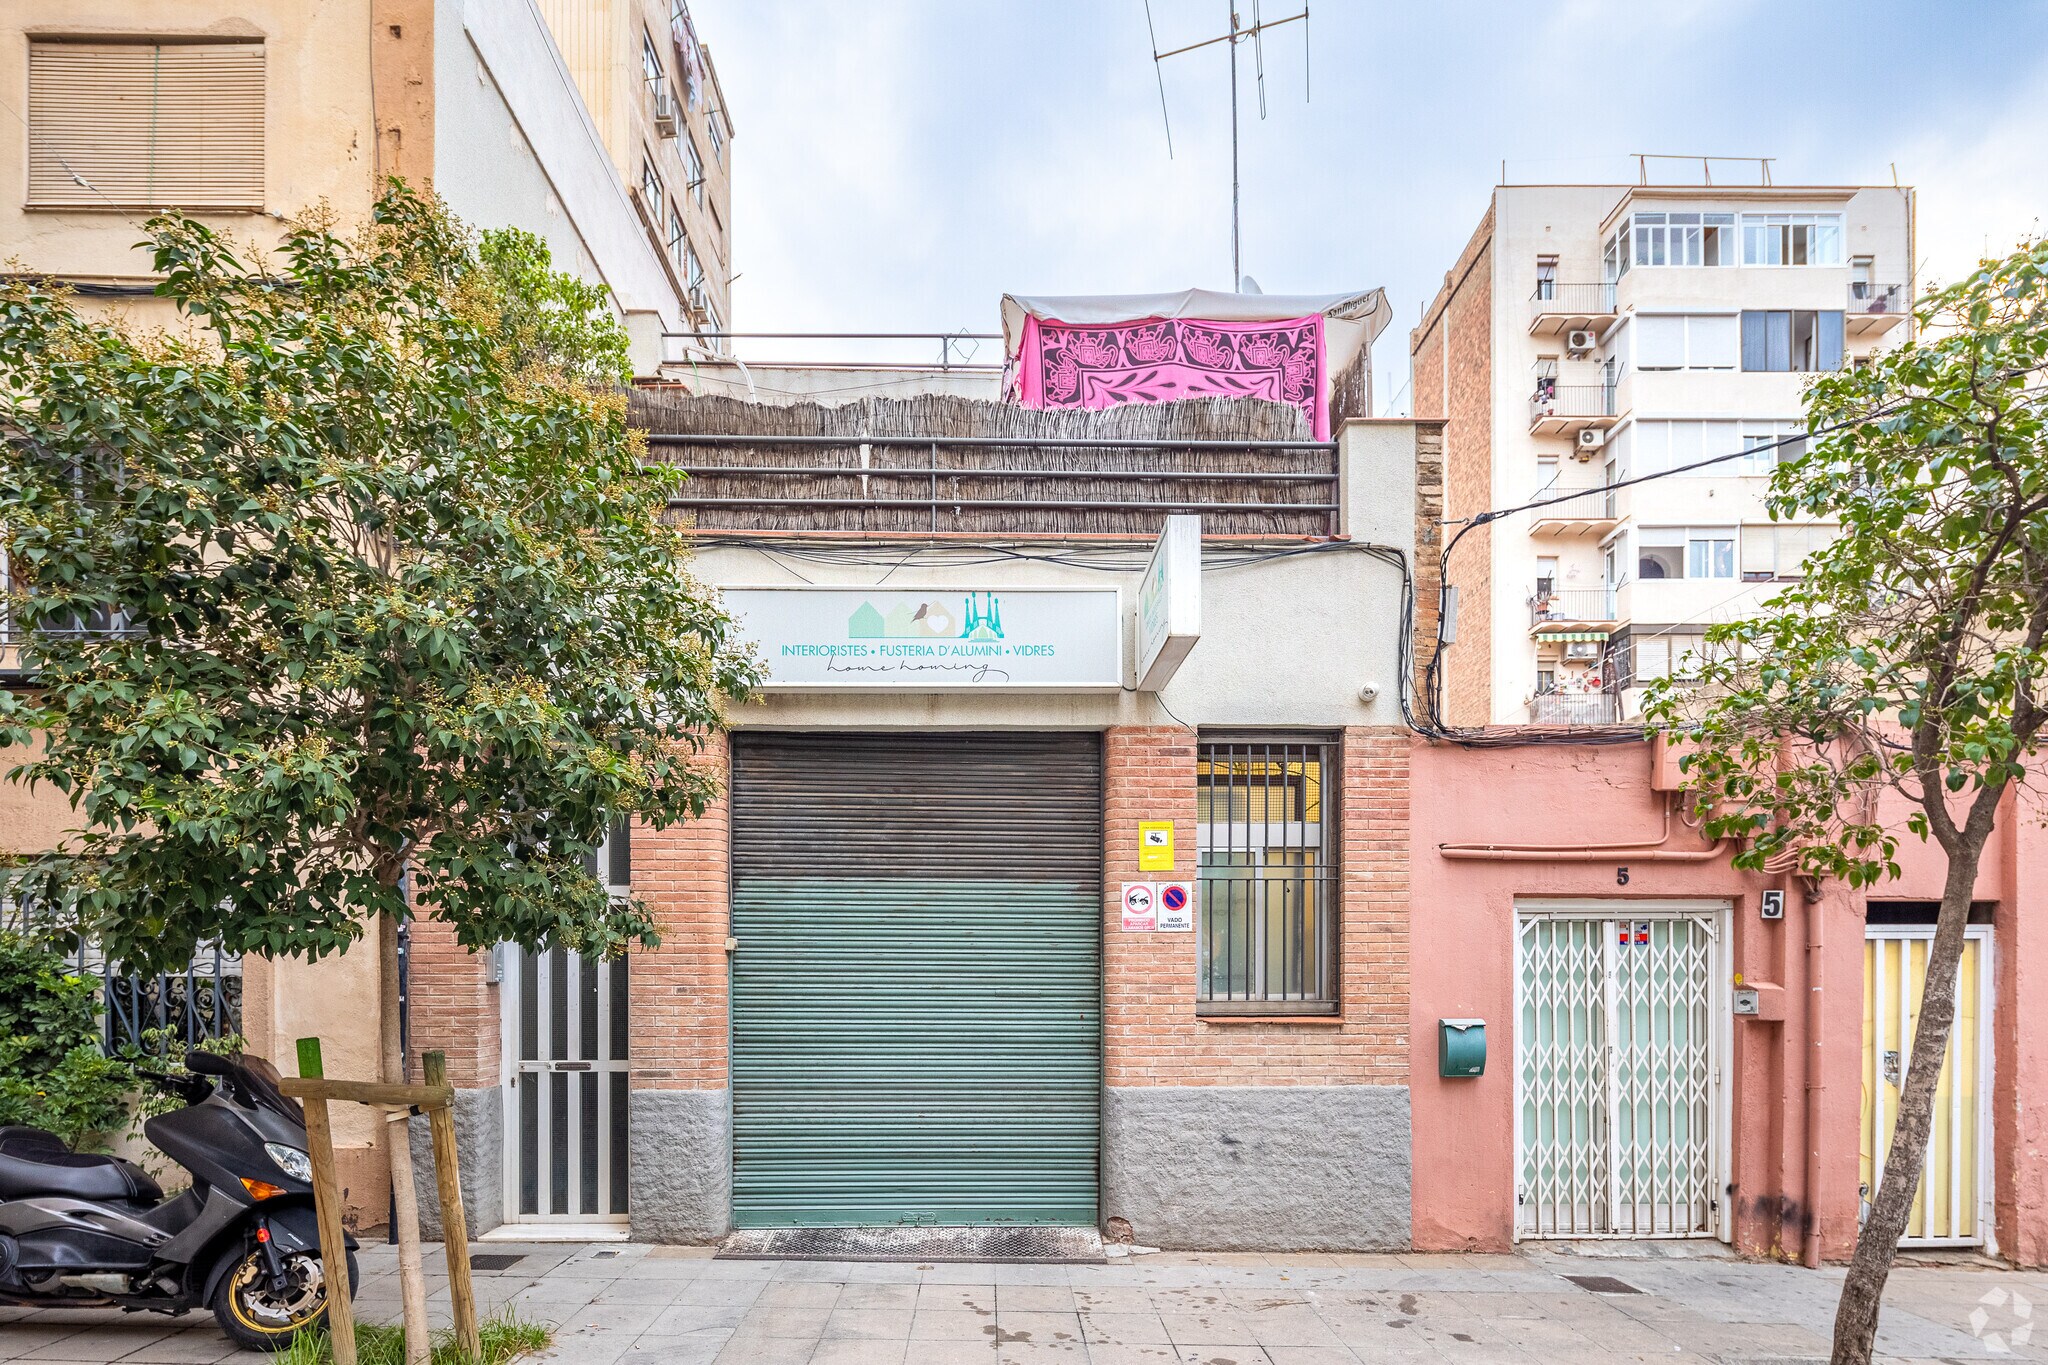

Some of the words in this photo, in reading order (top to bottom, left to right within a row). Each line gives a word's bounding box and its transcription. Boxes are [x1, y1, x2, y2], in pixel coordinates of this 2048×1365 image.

[781, 644, 868, 657] INTERIORISTES
[879, 644, 935, 657] FUSTERIA
[938, 644, 1002, 657] D'ALUMINI
[1012, 644, 1055, 657] VIDRES
[826, 653, 895, 672] home
[899, 660, 1010, 683] homing
[1616, 867, 1630, 886] 5
[1763, 891, 1781, 917] 5
